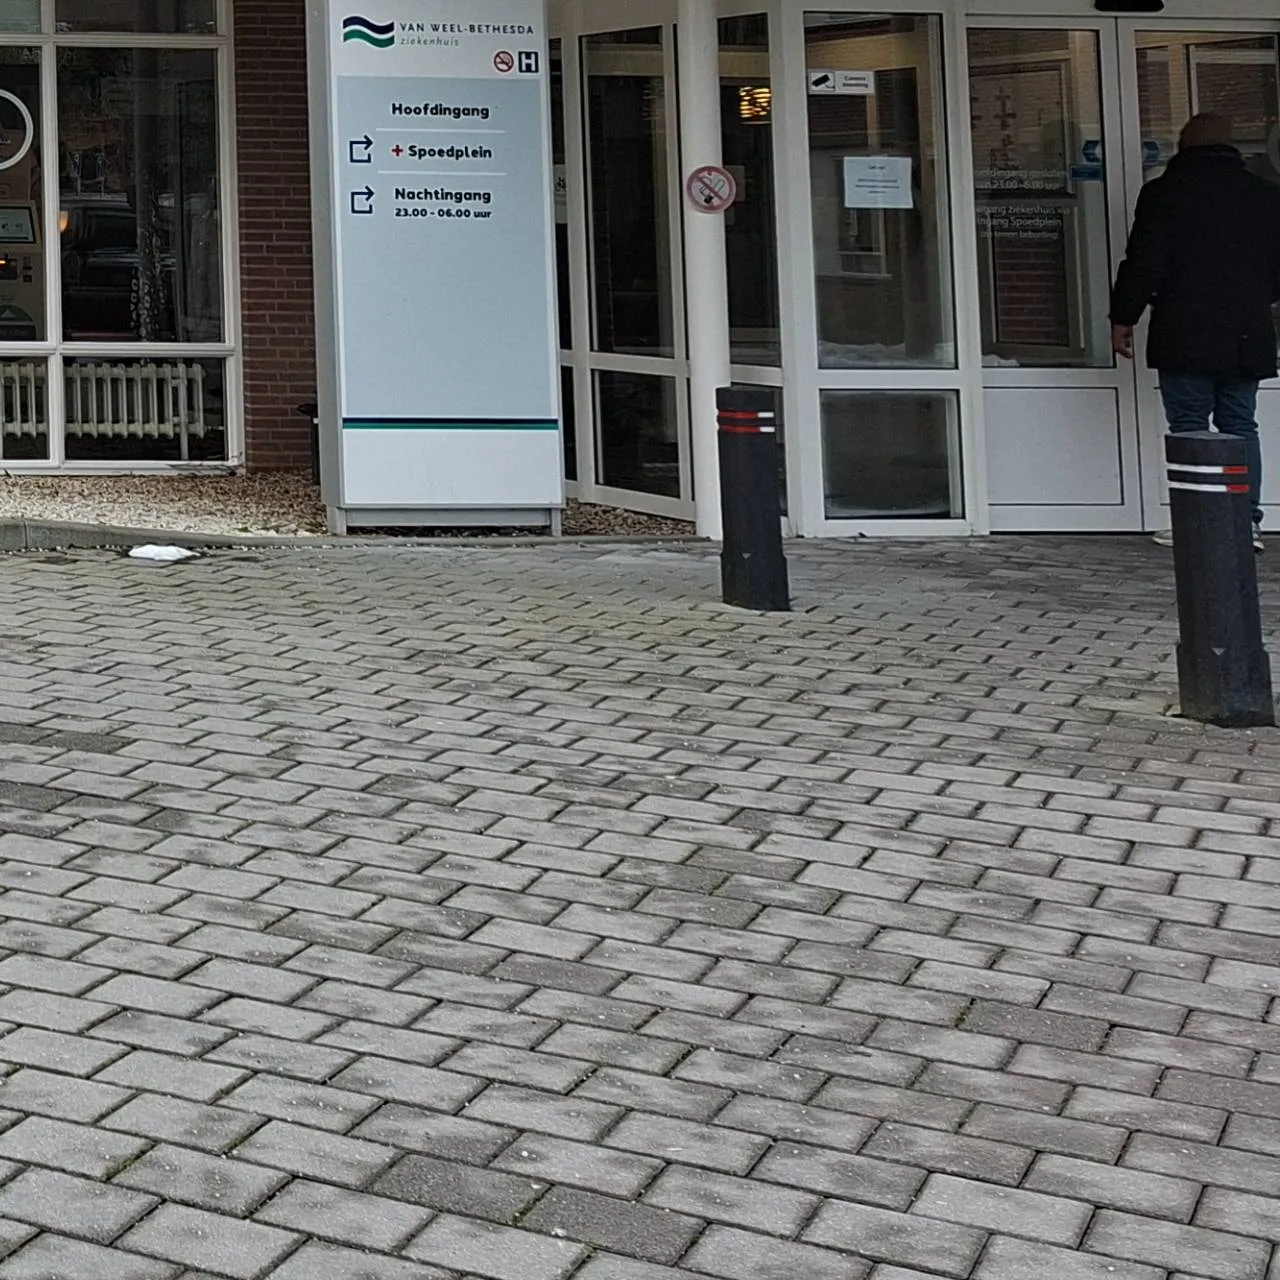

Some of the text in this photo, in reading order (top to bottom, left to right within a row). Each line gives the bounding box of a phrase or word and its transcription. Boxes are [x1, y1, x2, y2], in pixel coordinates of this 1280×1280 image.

[400, 23, 534, 35] VAN WEEL-BETHESDA
[400, 35, 460, 47] ziekenhuis
[391, 103, 490, 120] Hoofdingang
[408, 145, 493, 161] Spoedplein
[395, 188, 492, 204] Nachtingang
[395, 208, 428, 217] 23.00
[437, 208, 471, 218] 06.00
